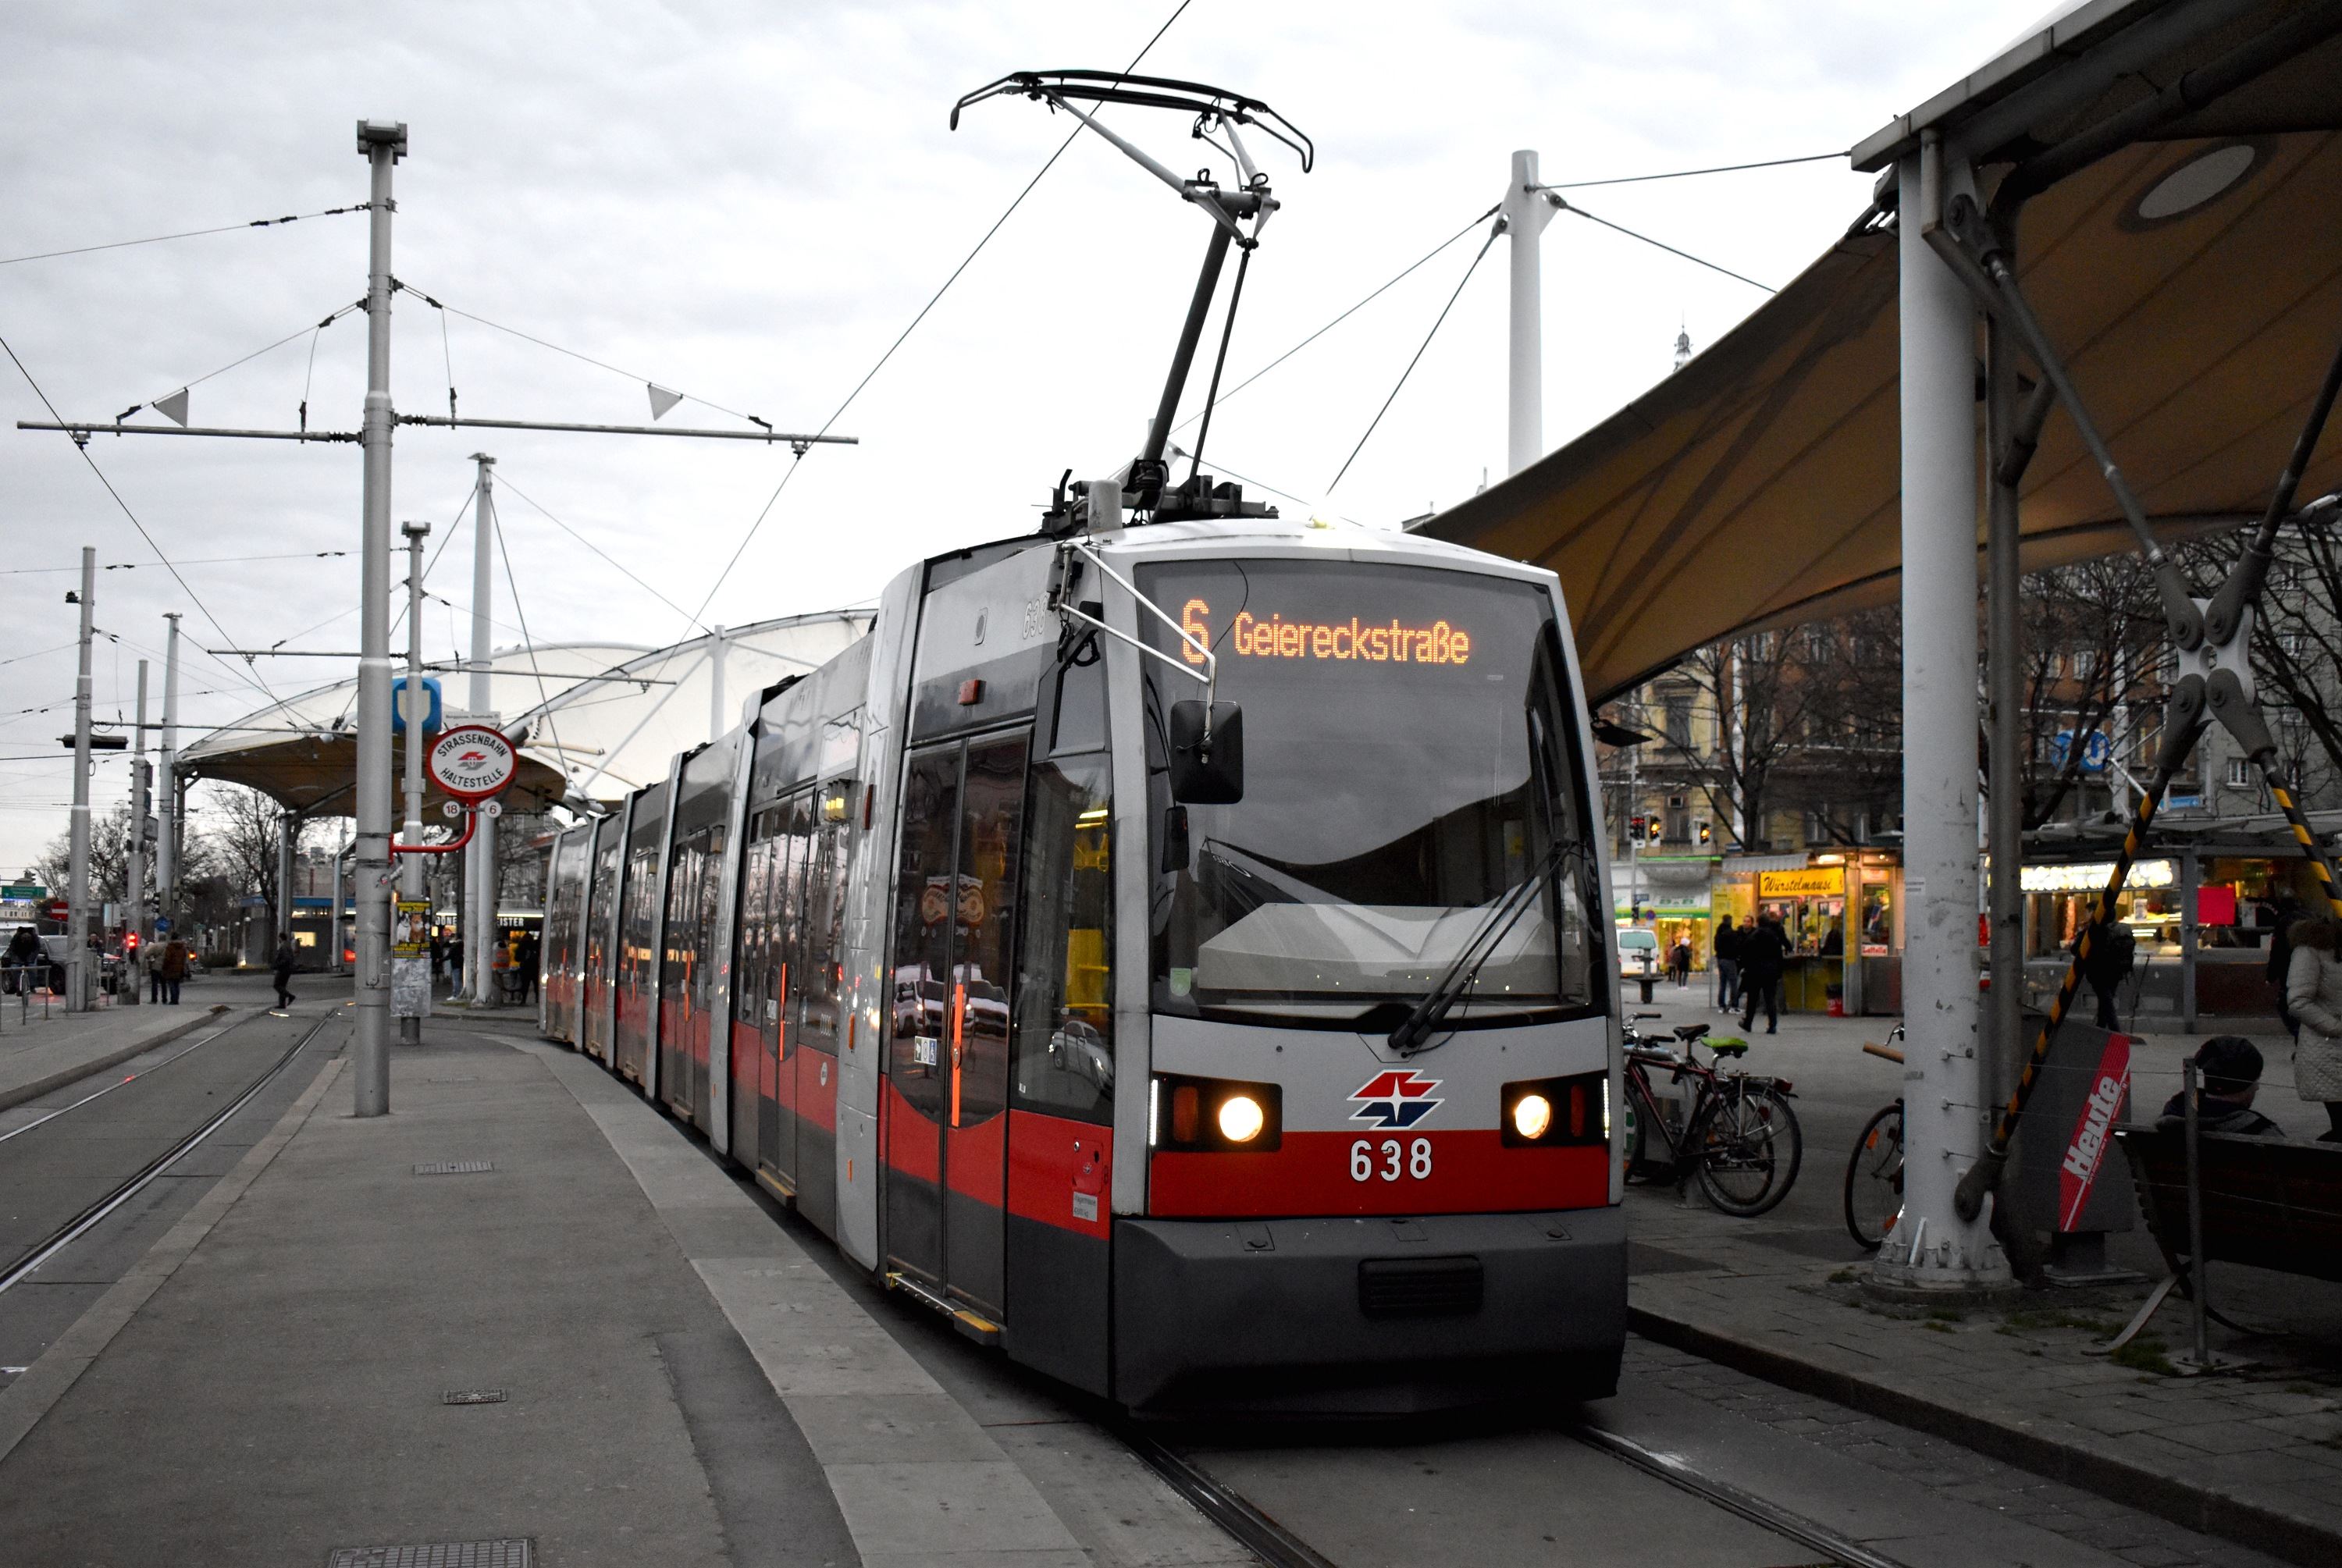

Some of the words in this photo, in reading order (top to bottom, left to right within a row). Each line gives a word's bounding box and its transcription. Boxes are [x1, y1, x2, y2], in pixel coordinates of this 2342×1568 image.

[1023, 596, 1048, 639] 638
[1183, 599, 1209, 663] 6
[1234, 612, 1469, 663] Geiereckstraße
[437, 734, 508, 758] STRASSENBAHN
[440, 768, 505, 788] HALTESTELLE
[446, 805, 457, 814] 18
[489, 805, 497, 815] 6
[1764, 876, 1832, 892] Würstelmausi
[497, 917, 524, 927] ISTER
[2063, 1076, 2120, 1182] Heute
[1351, 1138, 1432, 1182] 638
